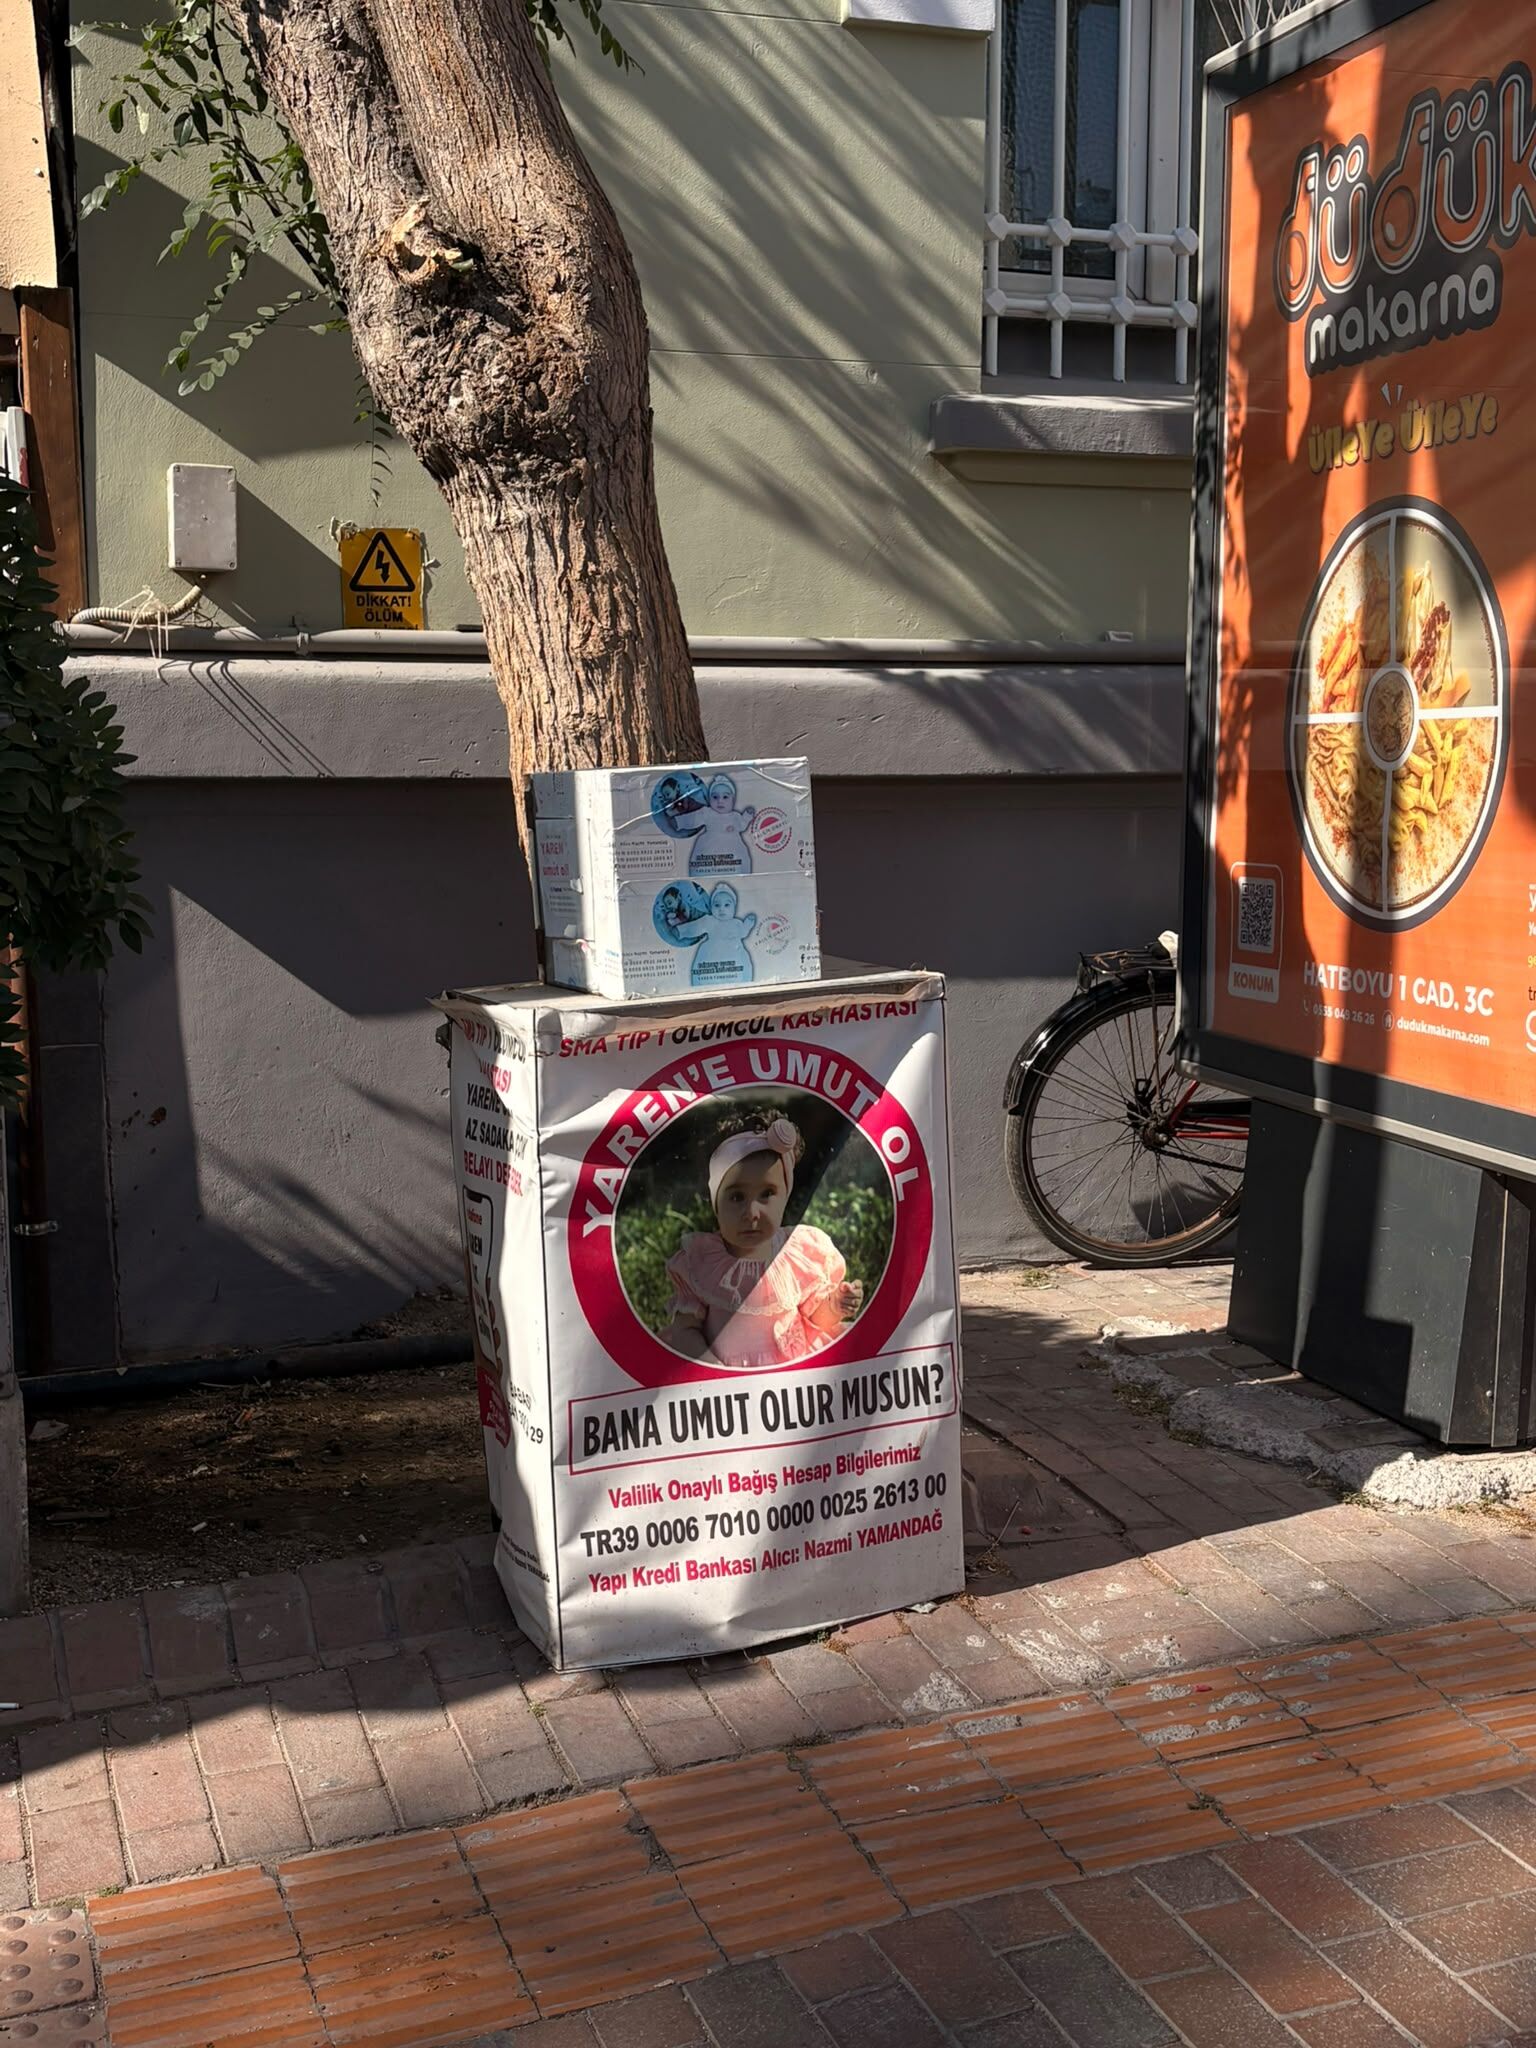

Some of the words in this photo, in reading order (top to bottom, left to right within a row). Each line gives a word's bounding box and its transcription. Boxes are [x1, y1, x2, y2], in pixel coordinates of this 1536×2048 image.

[1309, 263, 1496, 364] makarna
[356, 593, 411, 607] DİKKAT!
[364, 608, 403, 622] ÖLÜM
[1233, 971, 1274, 992] KONUM
[1304, 961, 1393, 998] HATBOYU
[1399, 975, 1407, 1001] 1
[1413, 977, 1460, 1011] CAD.
[1464, 986, 1495, 1017] 3C
[559, 1037, 607, 1058] SMA
[658, 1029, 666, 1046] 1
[781, 1010, 823, 1031] KAS
[830, 999, 919, 1025] HASTASI
[1397, 1017, 1490, 1046] dudukmakarna.com
[465, 1117, 478, 1141] AZ
[480, 1121, 514, 1152] SADAKA
[583, 1054, 736, 1238] YAREN'E
[749, 1049, 880, 1118] UMUT
[881, 1126, 919, 1201] OL
[464, 1150, 493, 1181] BELAYI
[583, 1405, 663, 1457] BANA
[669, 1393, 750, 1443] UMUT
[761, 1383, 834, 1433] OLUR
[842, 1363, 944, 1420] MUSUN?
[608, 1484, 663, 1509] Valilik
[668, 1475, 723, 1503] Onaylı
[729, 1469, 778, 1495] Bağış
[783, 1462, 832, 1487] Hesap
[836, 1443, 921, 1477] Bilgilerimiz
[581, 1524, 639, 1557] TR39
[646, 1516, 699, 1548] 0006
[706, 1510, 760, 1540] 7010
[767, 1502, 814, 1530] 0000
[821, 1490, 868, 1520] 0025
[874, 1481, 919, 1510] 2613
[925, 1472, 947, 1498] 00
[589, 1571, 627, 1595] Yapı
[633, 1565, 680, 1588] Kredi
[686, 1557, 757, 1581] Bankası
[761, 1545, 800, 1572] Alıcı:
[804, 1535, 852, 1561] Nazmi
[857, 1508, 942, 1547] YAMANDAĞ
